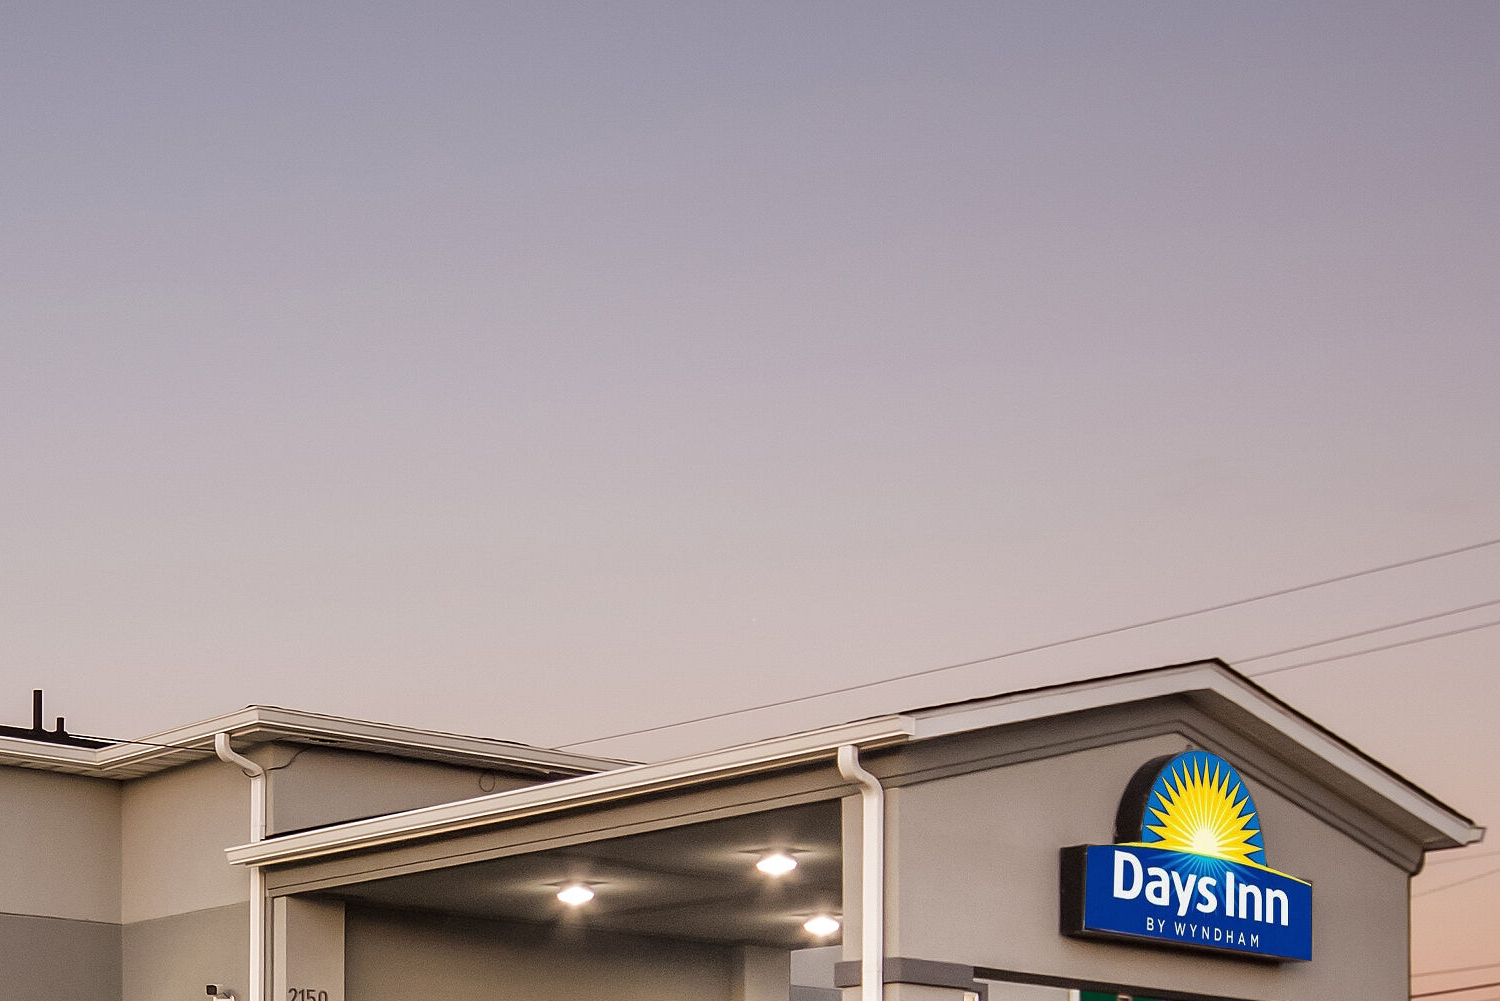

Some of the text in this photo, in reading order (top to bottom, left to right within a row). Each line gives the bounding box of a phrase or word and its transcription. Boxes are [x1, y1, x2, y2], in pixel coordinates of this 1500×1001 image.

[1113, 849, 1289, 927] Days Inn
[1146, 917, 1260, 948] BY WYNDHAM
